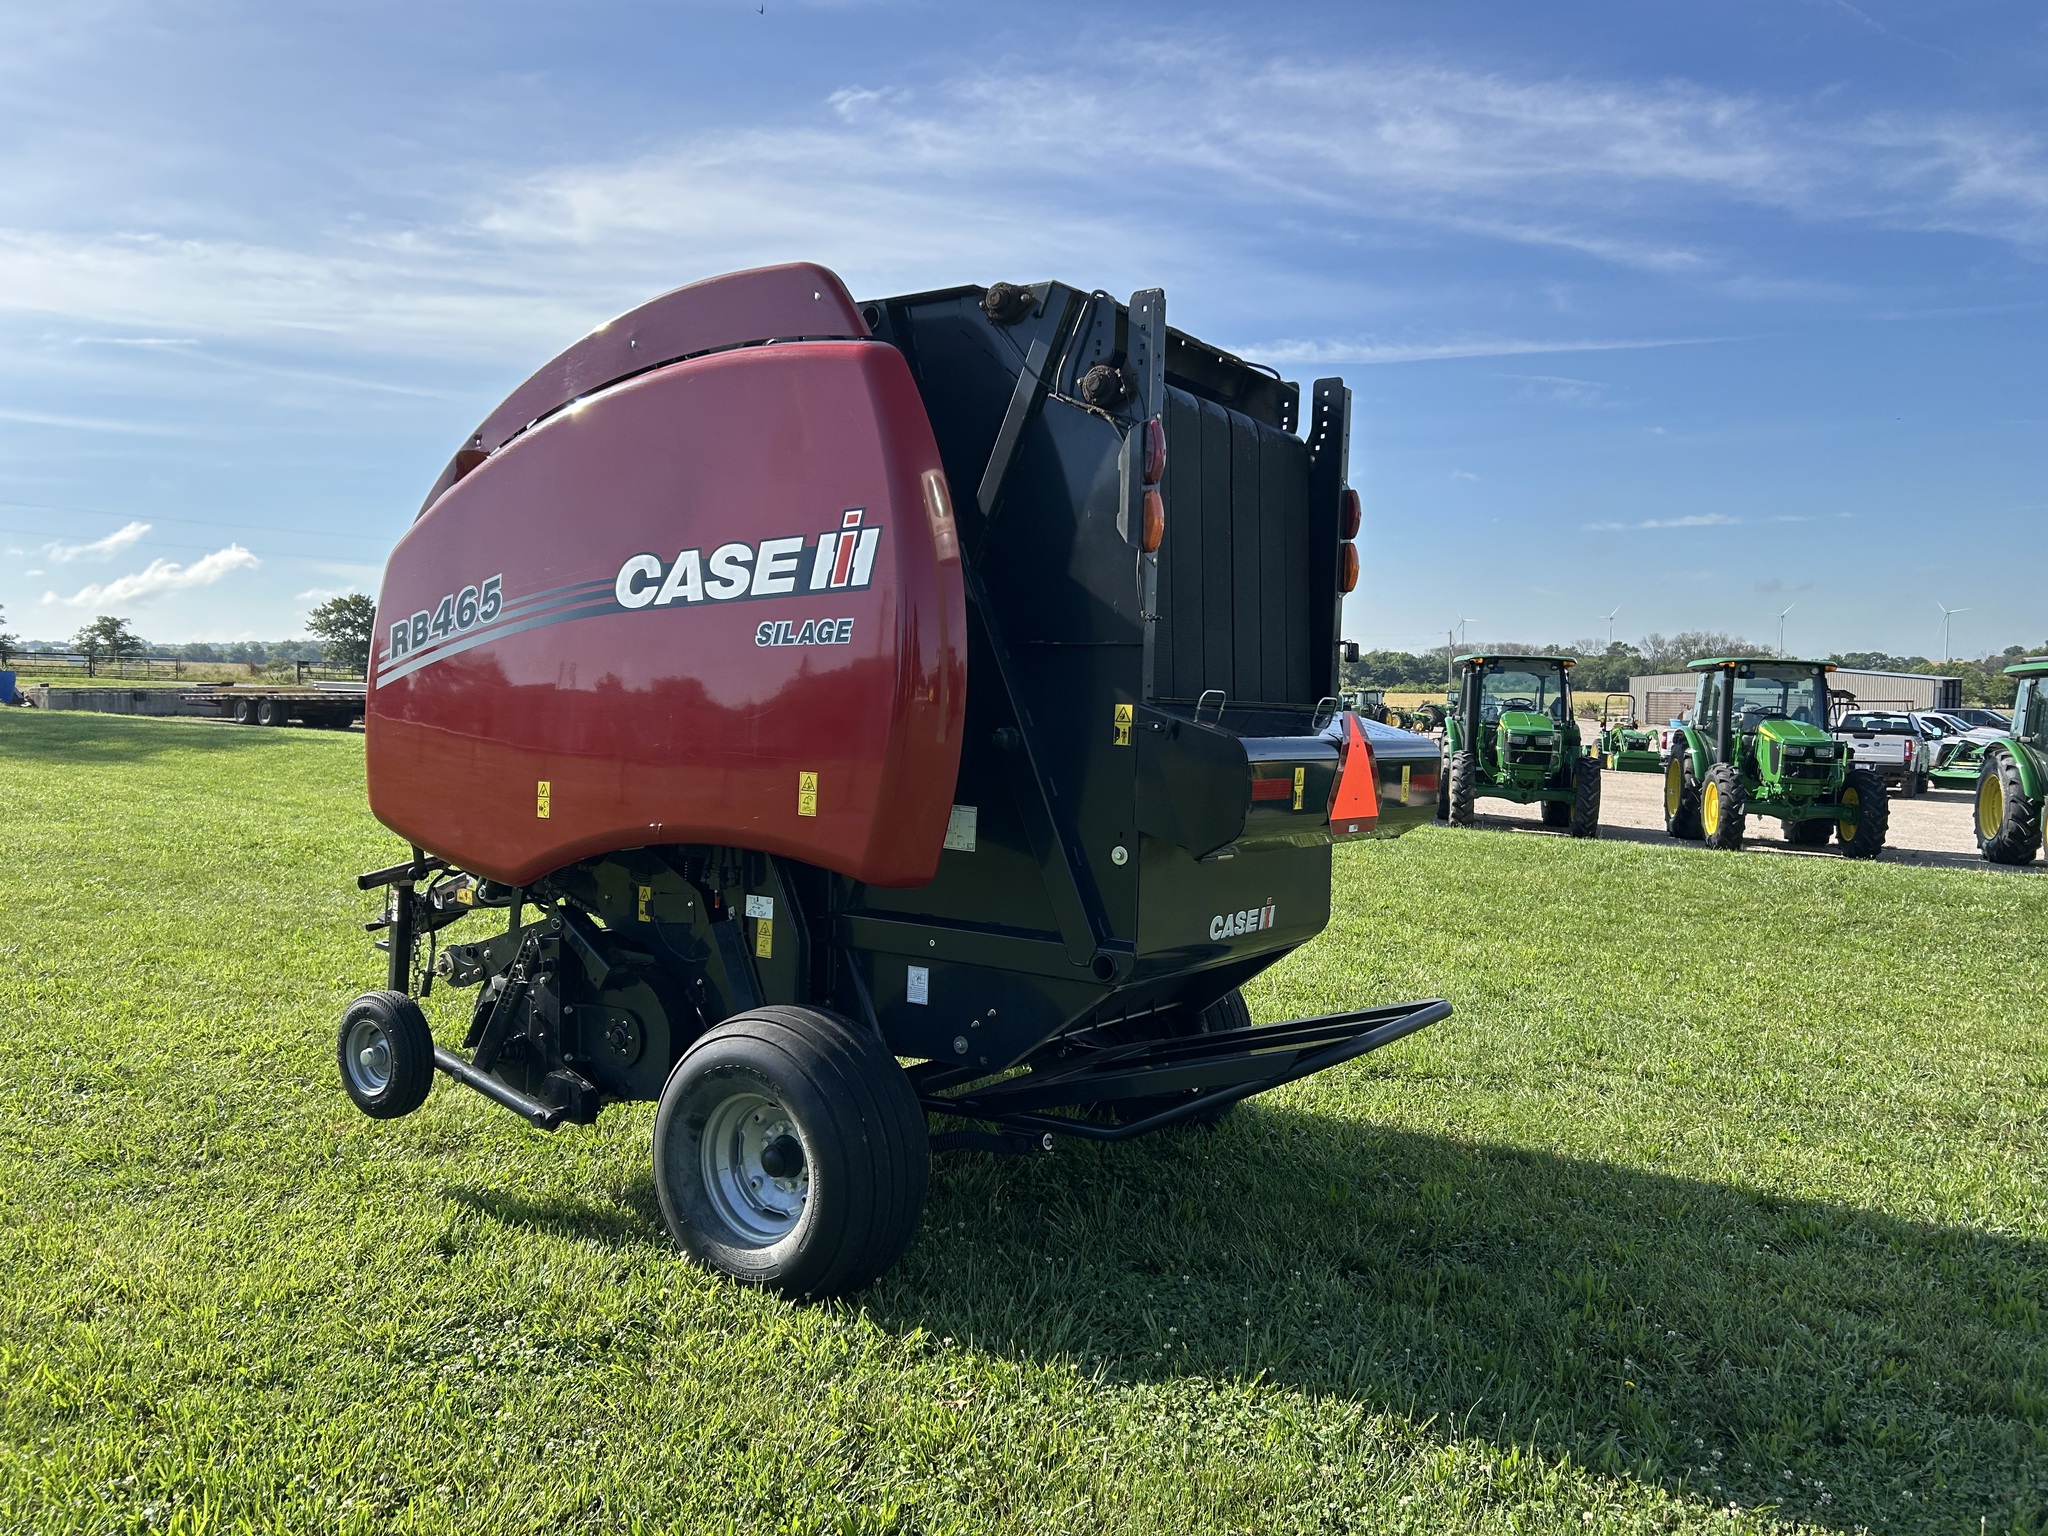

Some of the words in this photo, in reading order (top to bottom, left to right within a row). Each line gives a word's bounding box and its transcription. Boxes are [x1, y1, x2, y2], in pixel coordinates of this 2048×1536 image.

[615, 537, 803, 608] CASE
[389, 573, 503, 662] RB465
[755, 617, 854, 647] SILAGE
[1209, 908, 1260, 941] CASE
